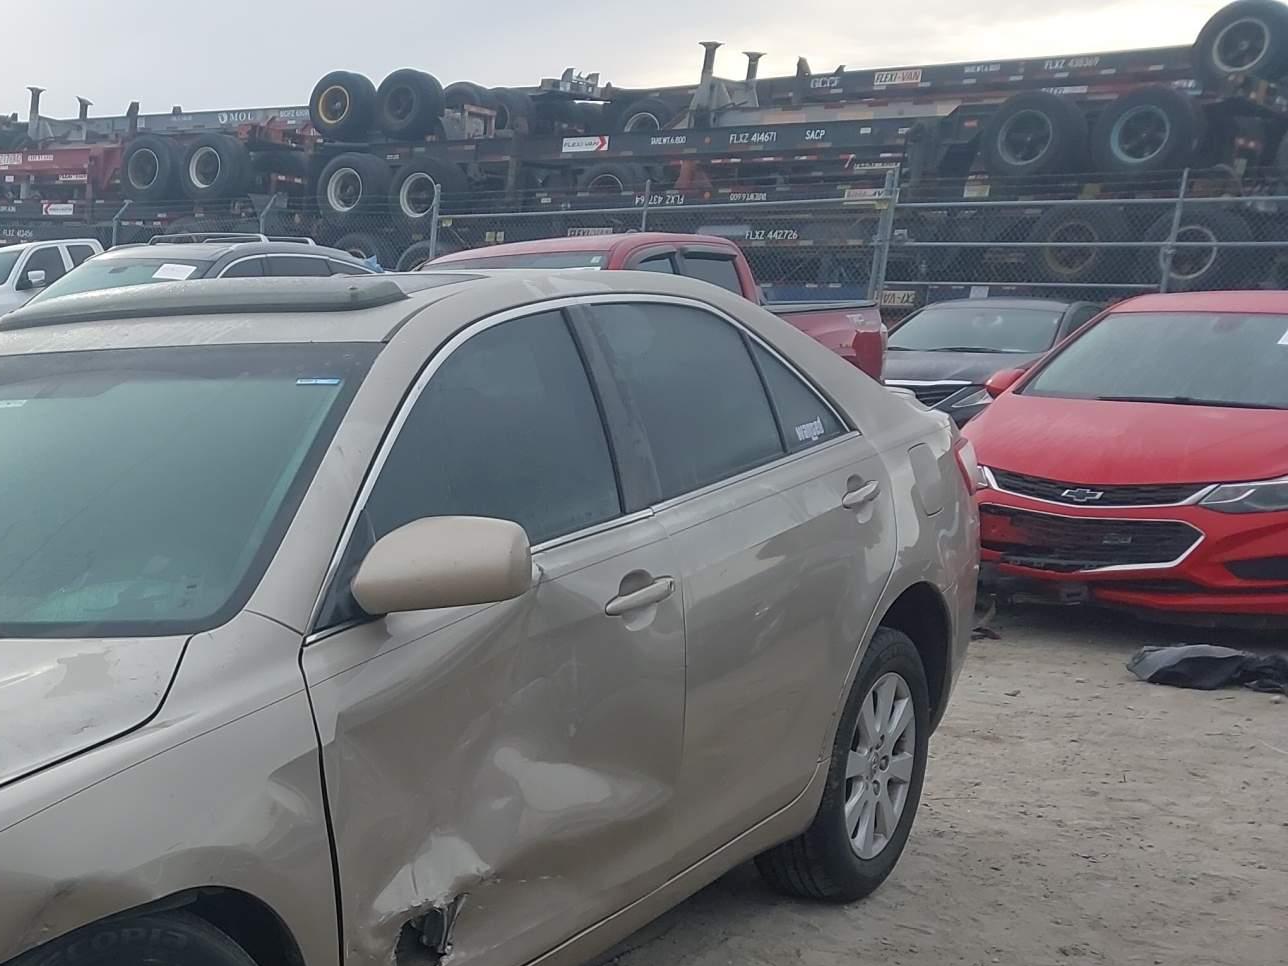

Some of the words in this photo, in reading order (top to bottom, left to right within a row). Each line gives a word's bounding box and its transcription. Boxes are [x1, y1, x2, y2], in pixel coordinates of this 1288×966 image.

[875, 71, 920, 84] FLEXI-VAN
[229, 112, 255, 121] MOL
[729, 133, 749, 144] FLXZ
[751, 131, 777, 143] 414671
[805, 129, 825, 141] SACP
[635, 194, 664, 206] 43764
[665, 194, 685, 205] FLXZ
[745, 230, 765, 240] FLXZ
[767, 229, 799, 240] 442726
